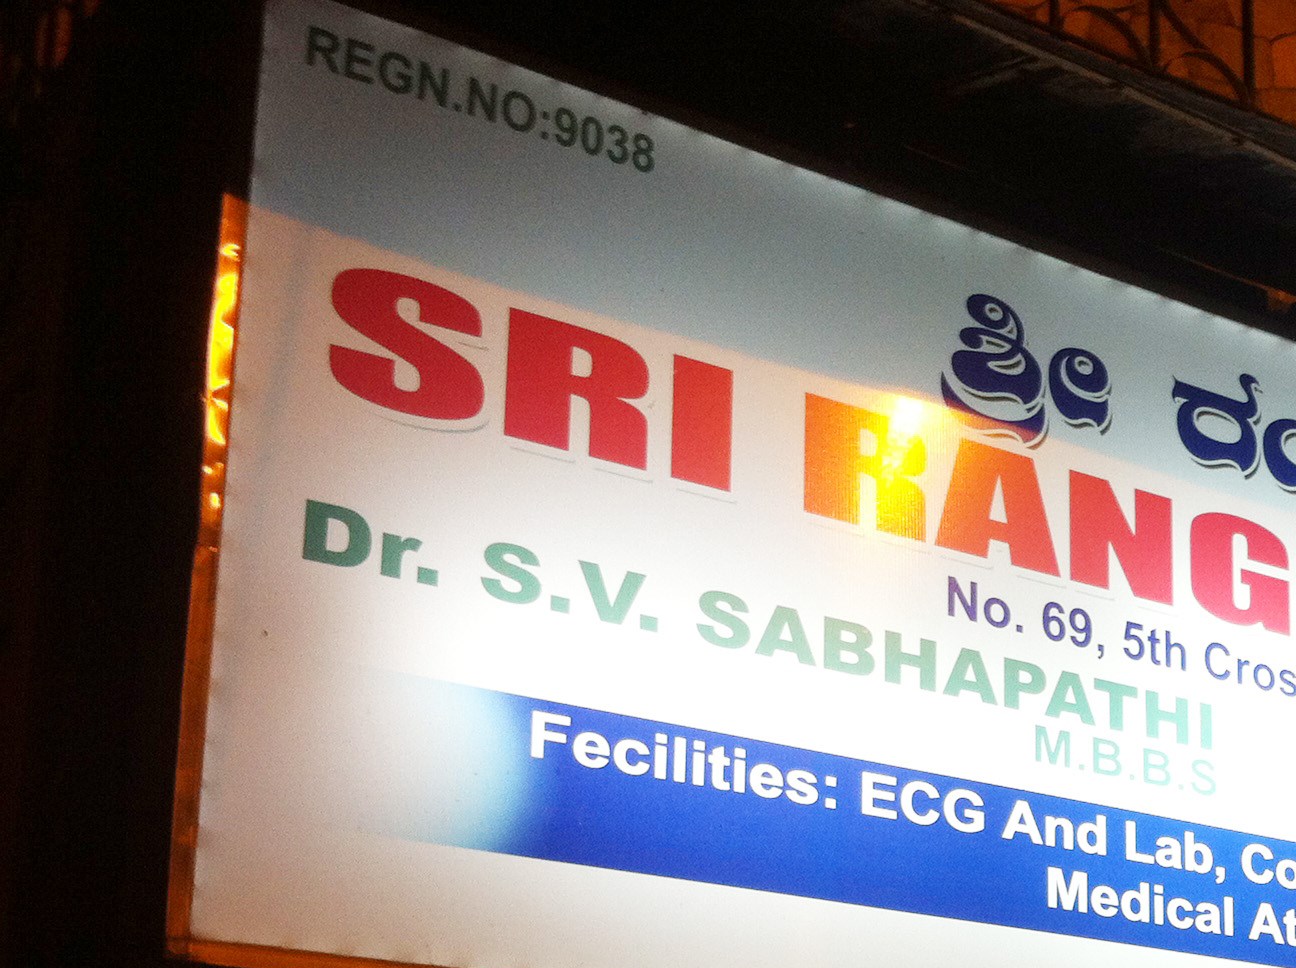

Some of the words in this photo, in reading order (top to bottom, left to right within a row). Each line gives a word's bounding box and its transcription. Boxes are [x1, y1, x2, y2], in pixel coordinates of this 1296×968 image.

[306, 27, 656, 172] REGN.NO:9038
[329, 267, 734, 493] SRI
[942, 293, 1111, 447] ಶ್ರೀ
[300, 498, 440, 588] Dr.
[480, 540, 661, 633] S.V.
[697, 589, 1215, 751] SABHAPATHI
[947, 575, 1025, 634] No.
[1042, 601, 1105, 659] 69,
[1123, 620, 1187, 671] 5th
[530, 709, 838, 810] Fecilities:
[859, 770, 986, 833] ECG
[1001, 800, 1108, 857] And
[1124, 819, 1227, 885] Lab,
[1033, 724, 1217, 797] M.B.B.S
[1046, 866, 1235, 938] Medical
